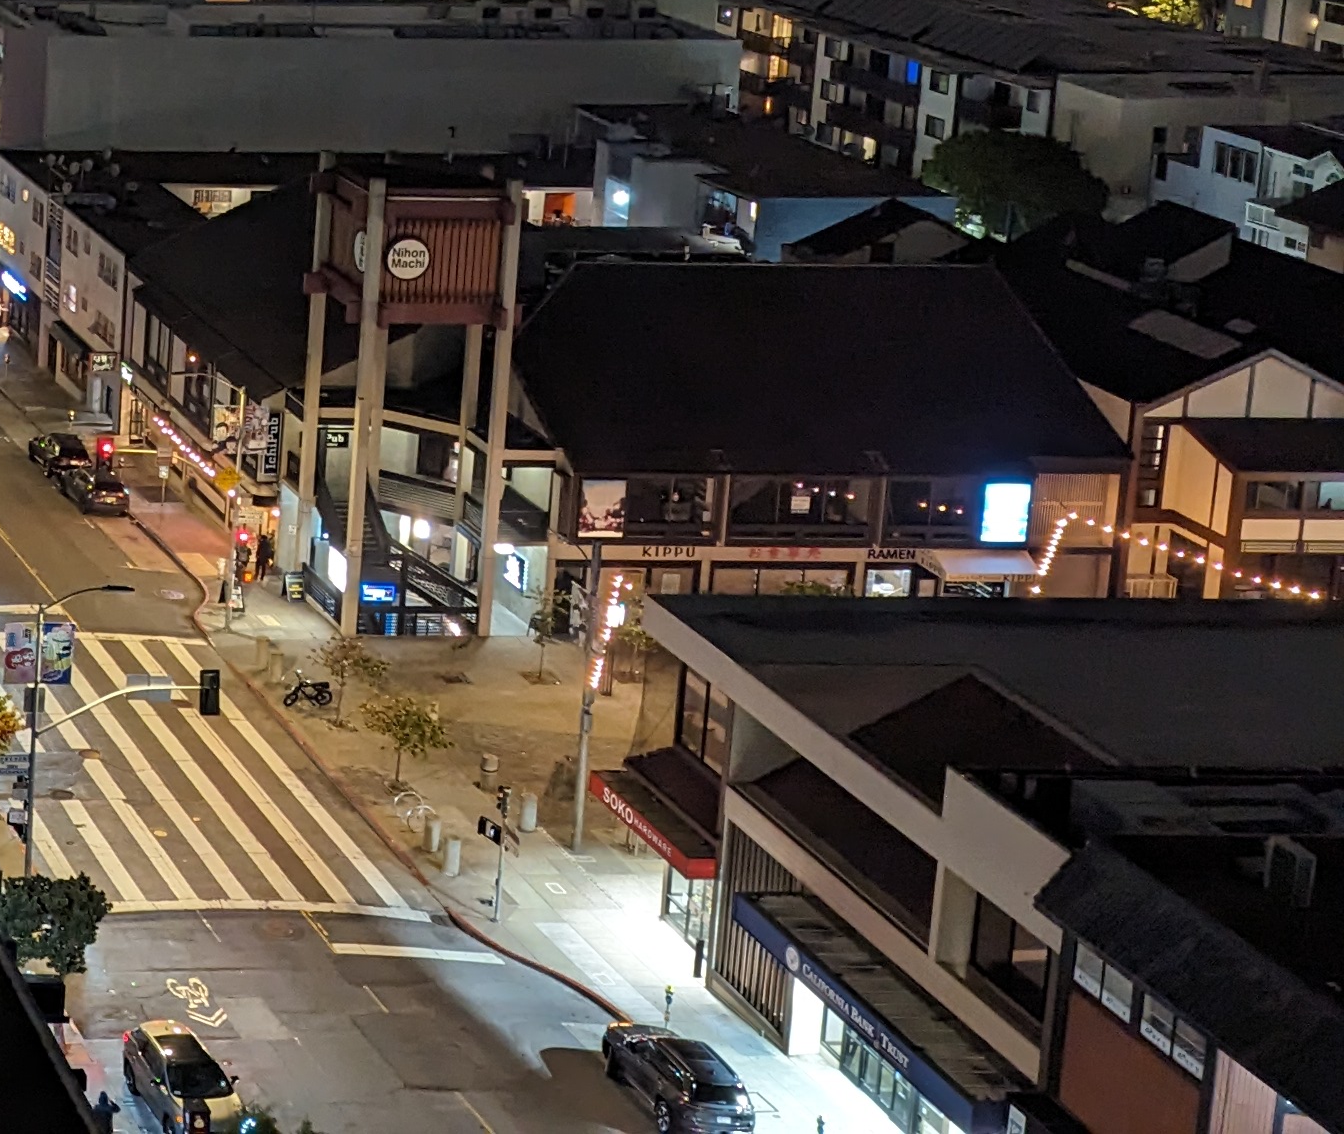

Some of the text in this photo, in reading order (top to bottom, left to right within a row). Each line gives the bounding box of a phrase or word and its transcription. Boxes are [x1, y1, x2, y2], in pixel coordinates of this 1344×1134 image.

[392, 247, 426, 258] Nihon
[391, 258, 425, 268] Machi
[642, 546, 696, 558] KIPPU
[867, 549, 916, 560] RAMEN
[602, 787, 672, 858] SOKO HARDWARE
